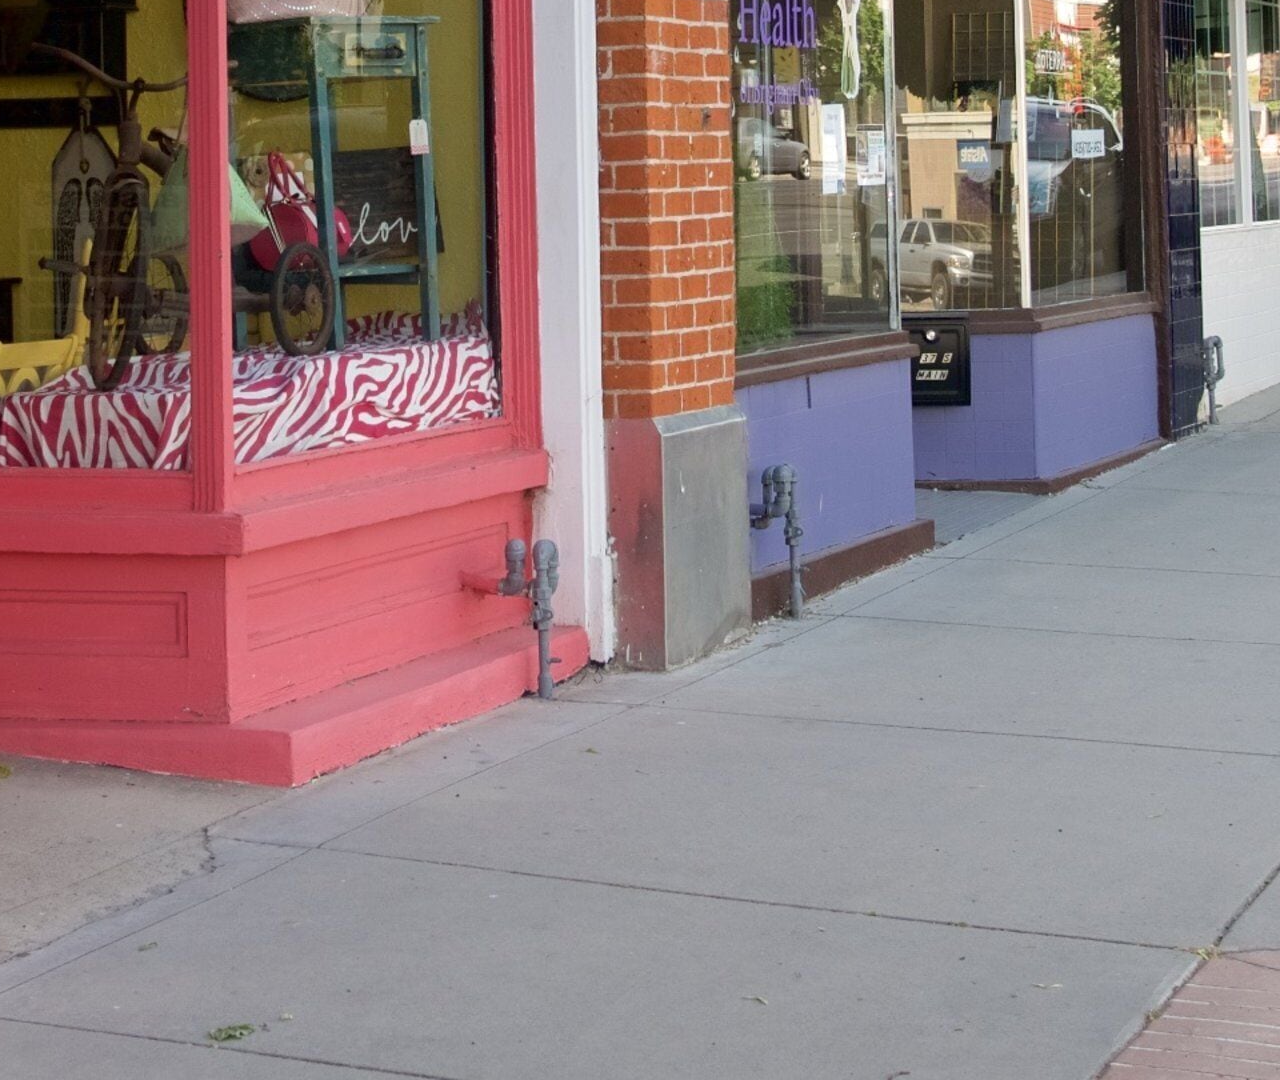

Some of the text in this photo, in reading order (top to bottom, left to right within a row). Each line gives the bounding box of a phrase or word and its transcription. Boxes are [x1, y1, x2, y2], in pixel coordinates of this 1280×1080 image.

[349, 202, 418, 248] lov
[920, 353, 952, 364] 37 S
[916, 369, 948, 381] MAIN
